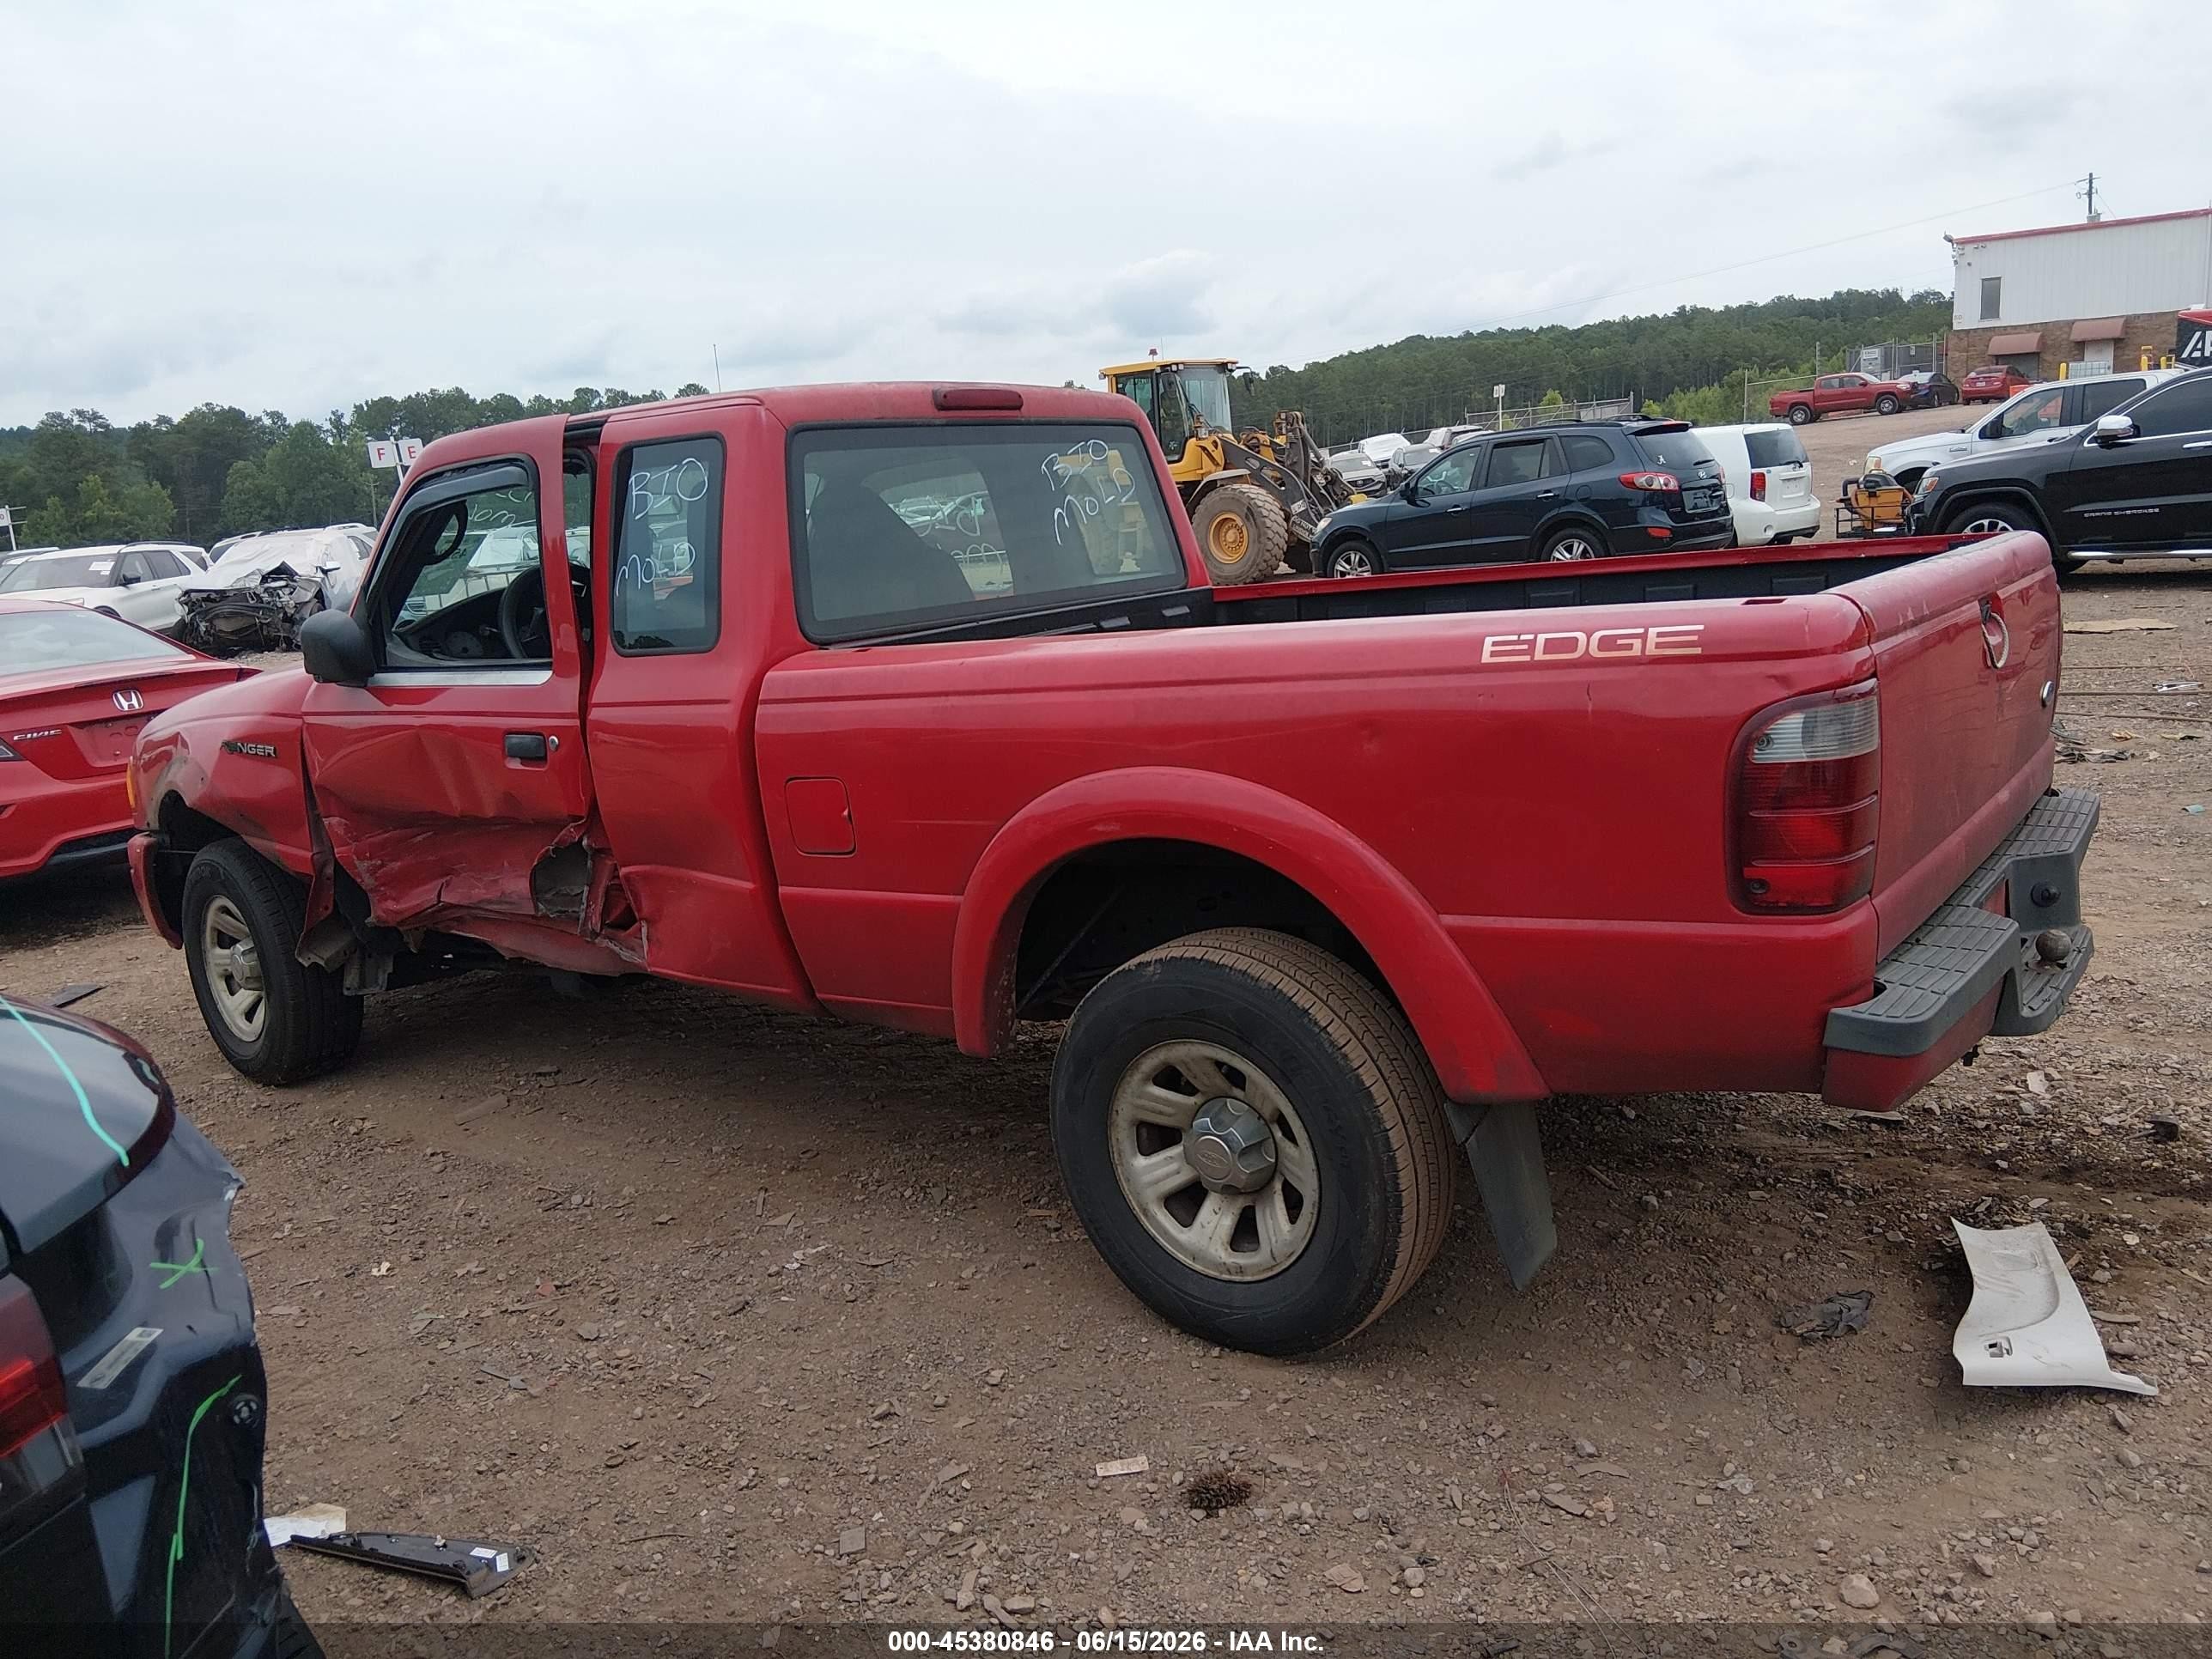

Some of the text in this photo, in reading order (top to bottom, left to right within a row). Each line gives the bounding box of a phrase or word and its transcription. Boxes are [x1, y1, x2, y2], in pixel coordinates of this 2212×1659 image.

[376, 447, 386, 461] F
[407, 446, 416, 459] E
[1041, 439, 1109, 492] BIO
[629, 458, 708, 520] BIO
[1480, 624, 1705, 664] EDGE
